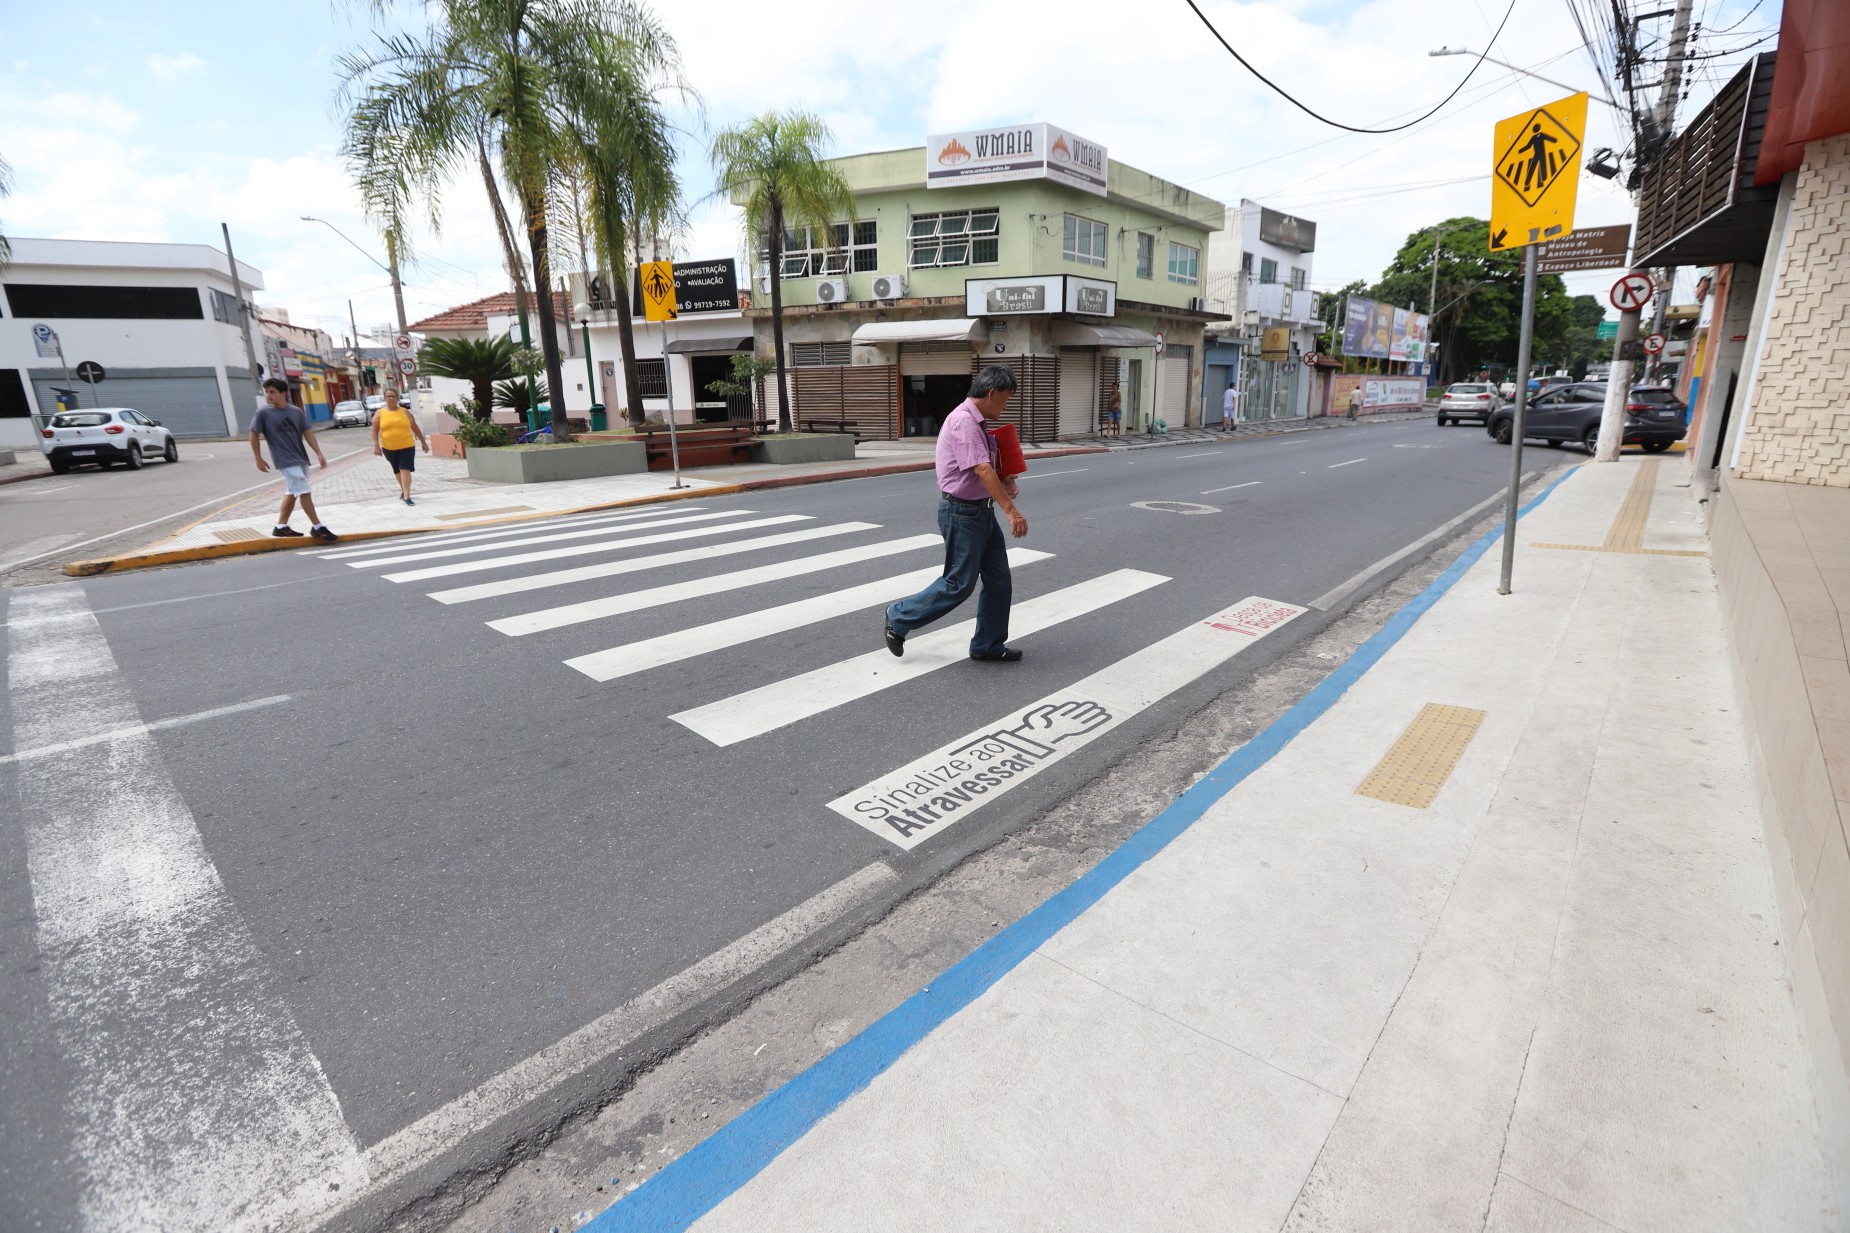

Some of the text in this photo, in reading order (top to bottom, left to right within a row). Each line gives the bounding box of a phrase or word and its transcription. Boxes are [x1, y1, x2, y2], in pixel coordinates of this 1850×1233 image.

[976, 130, 1033, 158] WMAIA
[1072, 139, 1102, 171] WMAIA
[1575, 231, 1606, 239] Matriz
[1548, 240, 1588, 250] Museu de
[1547, 248, 1604, 258] Antropologia
[1576, 259, 1621, 269] Liberdade
[694, 300, 731, 309] 99719-7592
[402, 362, 413, 370] 30
[854, 743, 1006, 820] Sinalize ao
[884, 753, 1036, 839] Atravessar
